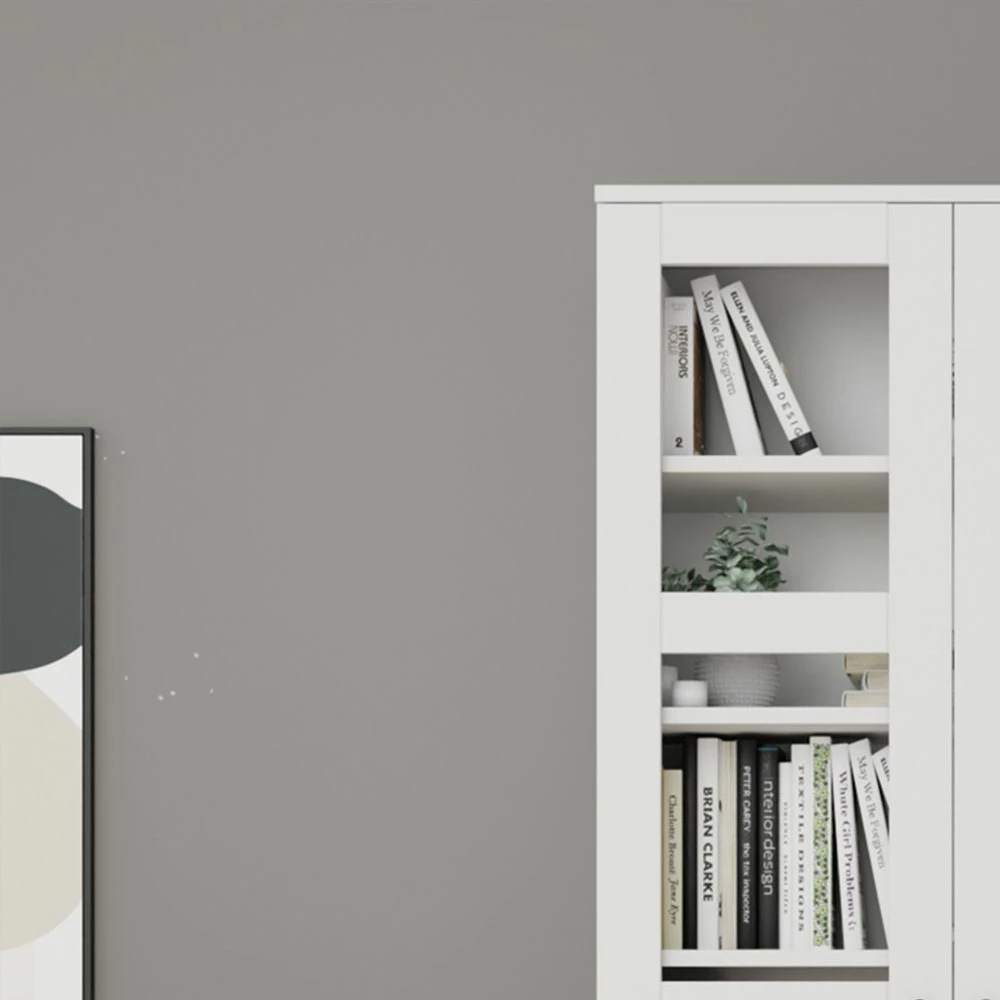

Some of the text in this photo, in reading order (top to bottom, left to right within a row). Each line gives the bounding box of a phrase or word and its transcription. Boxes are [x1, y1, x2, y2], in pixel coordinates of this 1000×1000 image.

[678, 325, 689, 379] INTERIORS
[702, 289, 736, 396] May We Be Forgiven
[730, 291, 746, 315] ELLEN
[741, 315, 754, 332] AND
[750, 334, 765, 354] JULIA
[760, 355, 779, 387] LUPTON
[675, 437, 683, 448] 2
[668, 795, 678, 840] Charlotte
[842, 821, 853, 849] Girl
[855, 755, 887, 870] May We Be Forgiven
[703, 787, 713, 902] BRIAN CLARKE
[741, 766, 751, 924] PETER CAREY the tax inspector
[667, 876, 679, 901] Jane
[668, 904, 679, 925] Eyre
[844, 853, 856, 918] Problems
